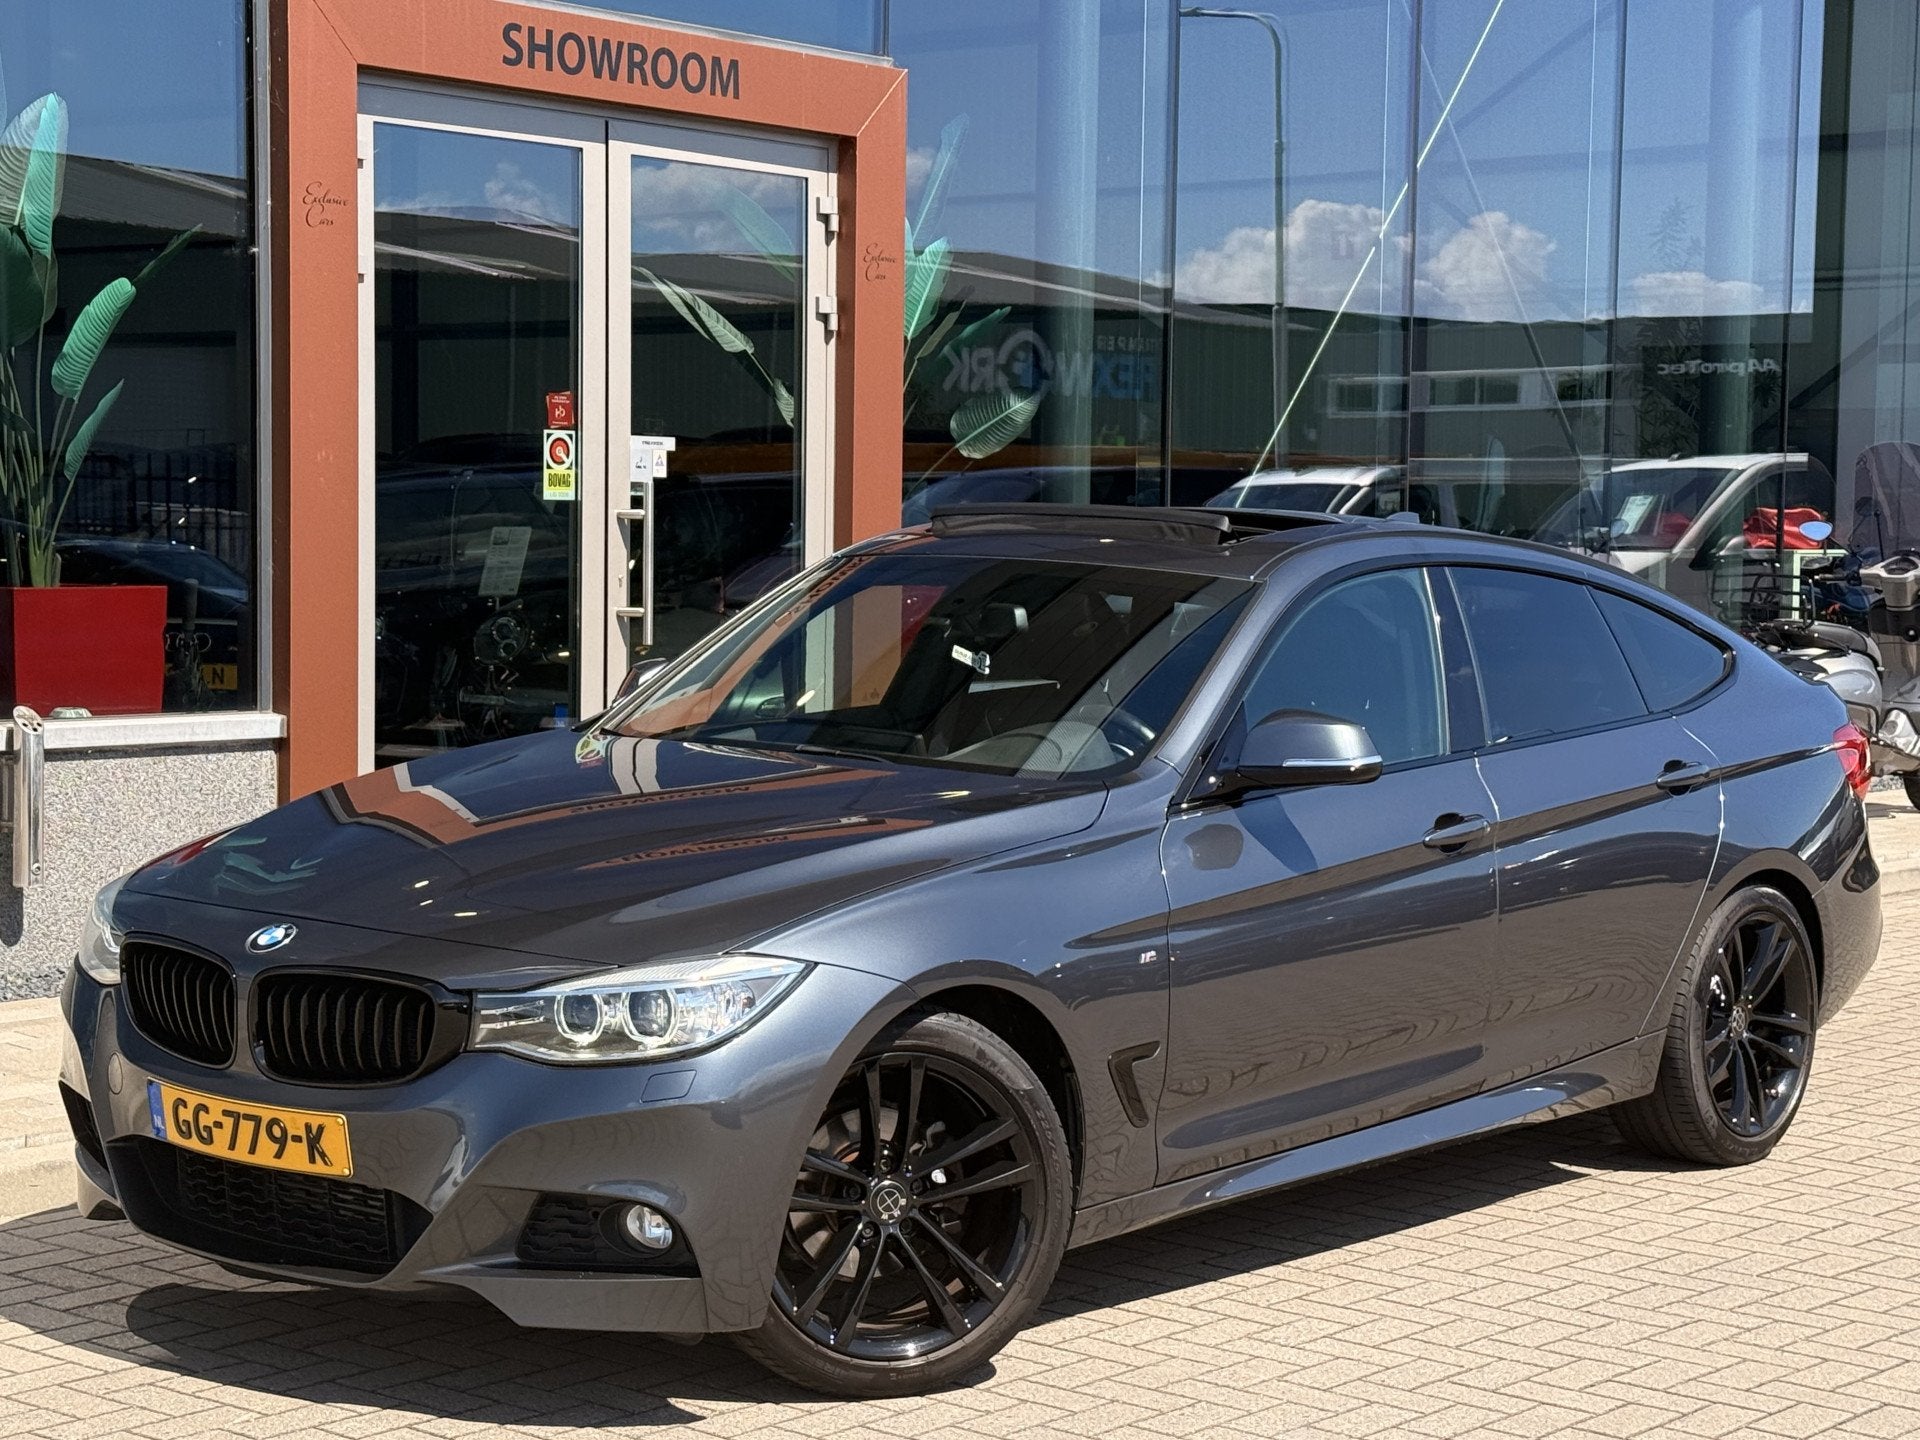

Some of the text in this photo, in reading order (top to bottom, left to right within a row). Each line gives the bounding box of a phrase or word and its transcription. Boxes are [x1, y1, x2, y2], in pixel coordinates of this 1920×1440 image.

[502, 22, 740, 100] SHOWROOM
[302, 180, 349, 207] Exclusive
[305, 204, 333, 228] Cars
[862, 242, 897, 264] Exclusive
[865, 262, 886, 282] Cars
[153, 1113, 166, 1129] NL
[172, 1097, 334, 1168] GG-779-K
